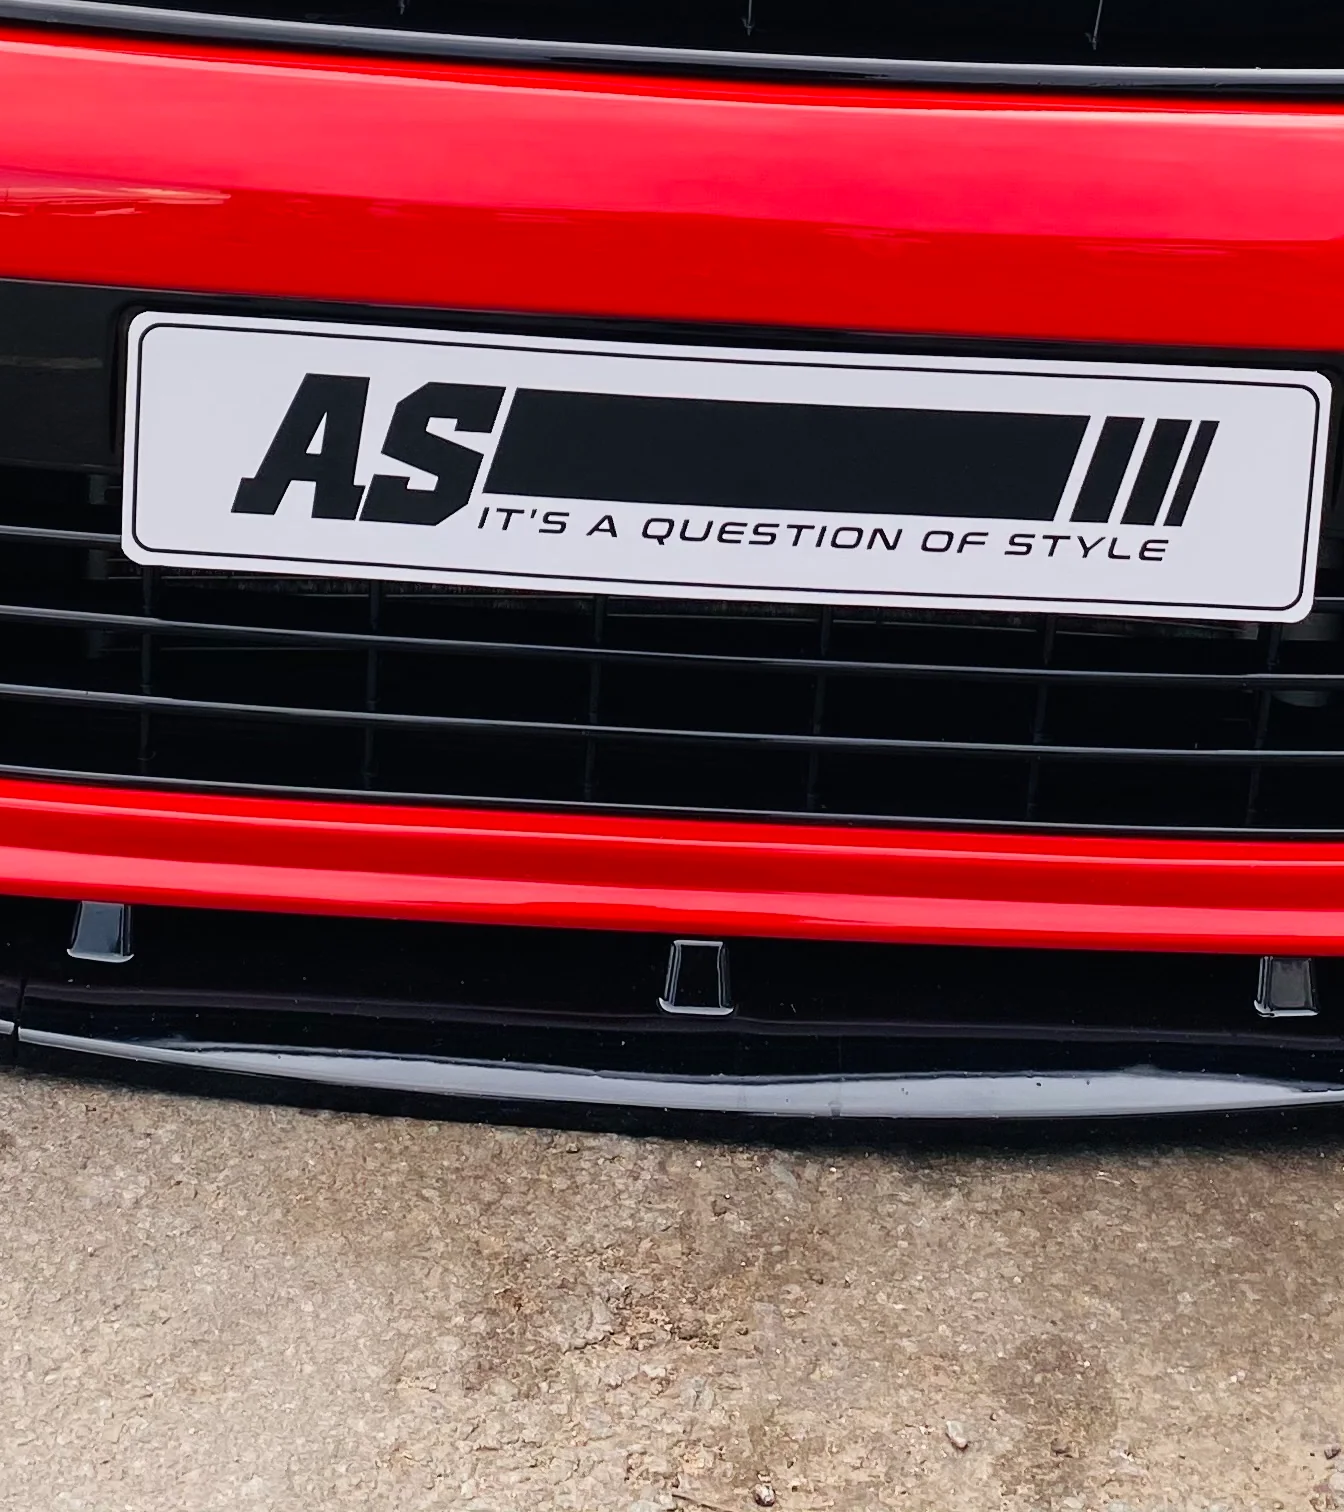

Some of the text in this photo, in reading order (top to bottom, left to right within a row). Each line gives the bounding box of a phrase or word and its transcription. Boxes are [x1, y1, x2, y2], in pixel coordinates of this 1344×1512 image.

[231, 372, 507, 527] AS
[478, 506, 1170, 563] IT'S A QUESTION OF STYLE
